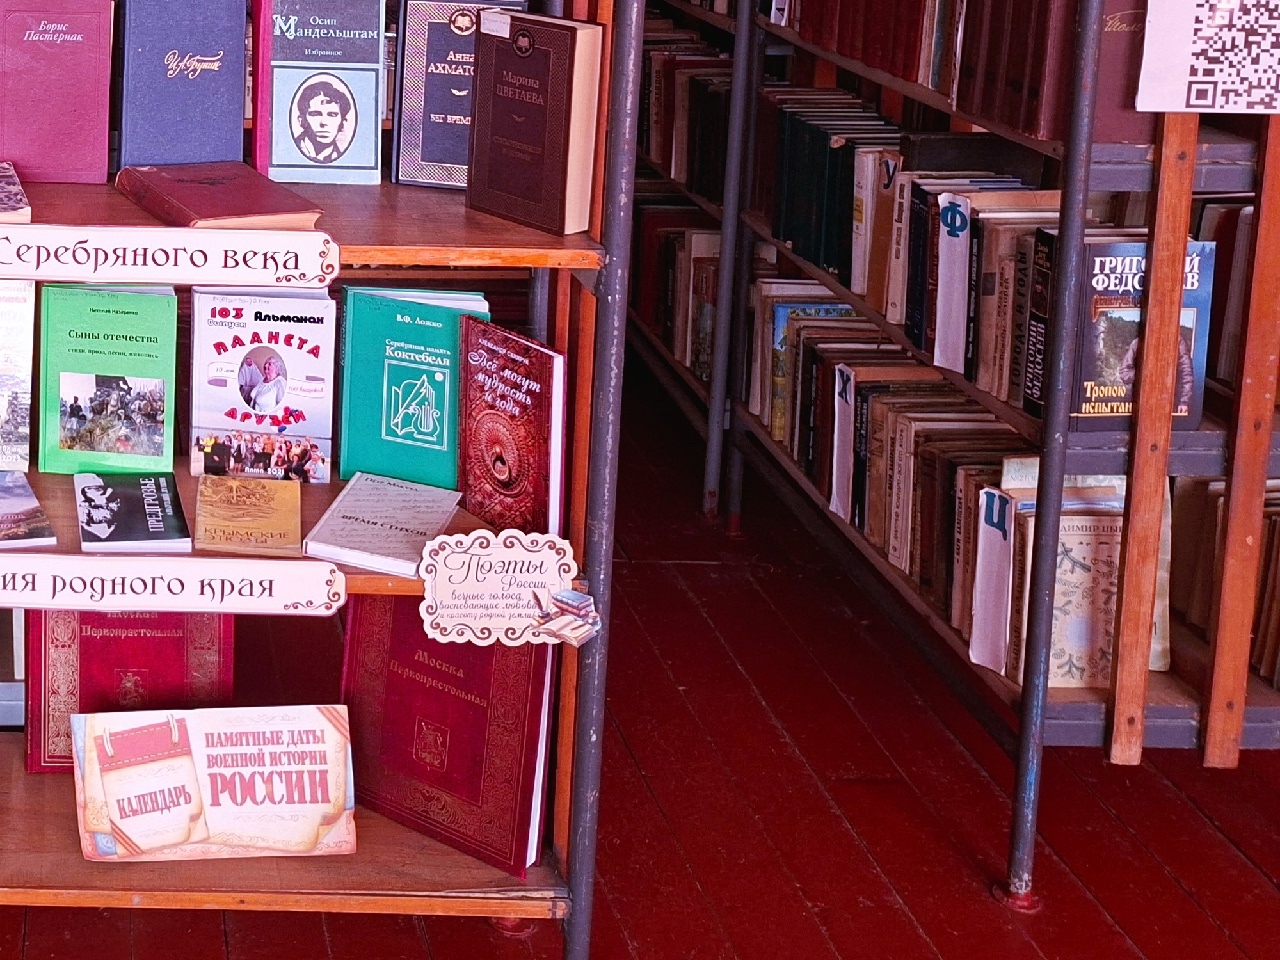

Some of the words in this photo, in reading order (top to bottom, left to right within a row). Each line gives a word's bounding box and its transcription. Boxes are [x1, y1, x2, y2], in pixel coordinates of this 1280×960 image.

[37, 20, 69, 32] Борис
[272, 14, 378, 40] Мандельштам
[309, 15, 337, 26] Осип
[23, 31, 84, 43] Пастернак
[304, 48, 343, 57] Избранное
[503, 70, 539, 88] Марина
[496, 84, 544, 106] ЦВЕТАЕВА
[940, 201, 969, 238] Ф
[221, 248, 301, 276] века
[207, 318, 247, 329] Выпуск
[210, 306, 244, 320] 103
[253, 310, 324, 325] Альманах
[396, 314, 413, 324] В.Ф.
[415, 316, 443, 329] Ложко
[68, 329, 100, 340] Сыны
[103, 331, 158, 344] отечества
[212, 331, 321, 359] ПЛАНЕТА
[384, 345, 451, 367] Коктебеля
[1024, 319, 1038, 397] ГРИГОРИЙ
[1032, 323, 1046, 398] ФЕДОСЕЕВ
[468, 349, 498, 373] Всё
[501, 365, 541, 393] могут
[474, 372, 532, 406] мудрость
[837, 368, 852, 405] Х
[1083, 380, 1127, 405] Тропою
[495, 394, 520, 416] года
[223, 406, 307, 427] ДРУЗЕЙ
[148, 476, 164, 532] ПРЕДГРОЗЬЕ
[340, 514, 379, 527] ВРЕМЯ
[380, 522, 428, 536] СТИХОВ
[983, 490, 1010, 541] Ц
[203, 527, 290, 539] КРЫМСКИЕ
[443, 551, 549, 585] Поэты
[50, 571, 186, 601] родного
[198, 577, 275, 605] края
[500, 574, 549, 592] России
[451, 589, 485, 603] вечные
[488, 592, 525, 602] голоса,
[80, 625, 184, 639] Первопрестольная
[413, 647, 466, 679] Москва
[389, 659, 488, 708] Первопрестольная
[204, 730, 284, 748] ПАМЯТНЫЕ
[286, 729, 327, 748] ДАТЫ
[206, 748, 267, 769] ВОЕННОЙ
[269, 748, 328, 767] ИСТОРИИ
[207, 769, 332, 807] РОССИИ
[115, 783, 193, 820] КАЛЕНДАРЬ
